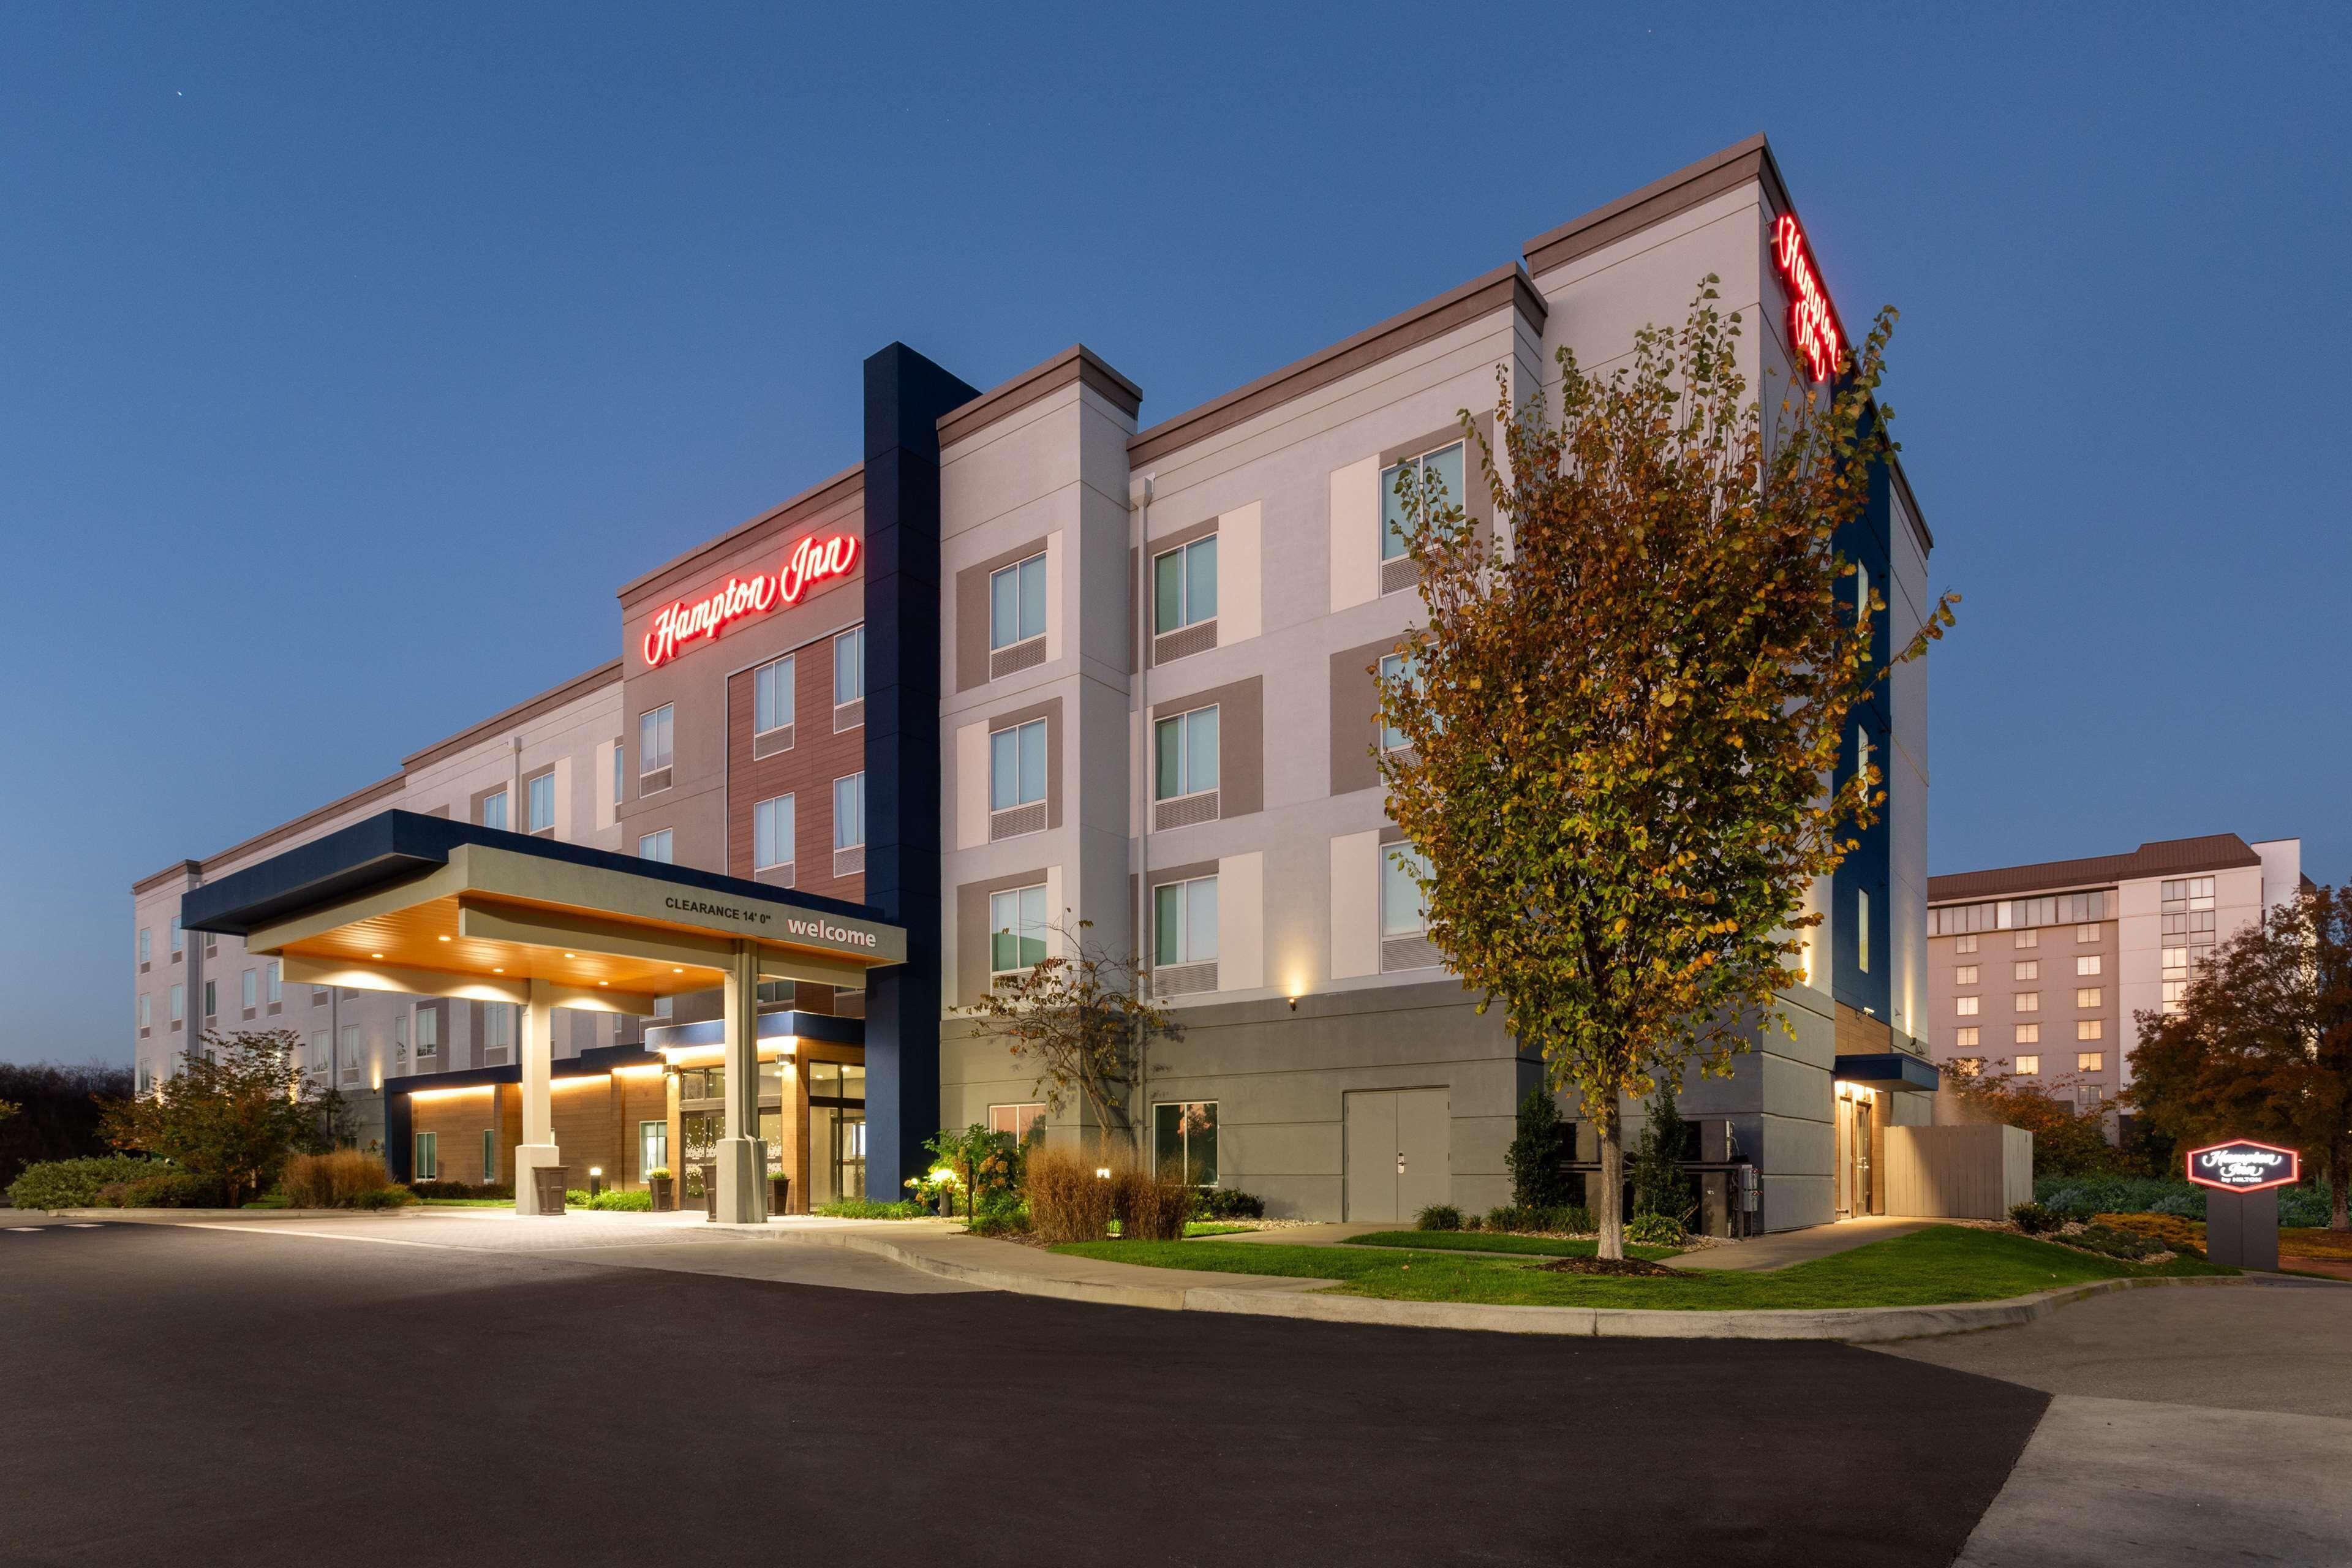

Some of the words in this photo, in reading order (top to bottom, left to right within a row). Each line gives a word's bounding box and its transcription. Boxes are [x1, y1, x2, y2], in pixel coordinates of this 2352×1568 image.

[1779, 216, 1841, 371] Hampton
[1795, 301, 1825, 381] Inn
[644, 575, 777, 665] Hampton
[781, 537, 858, 603] Inn
[665, 897, 740, 920] CLEARANCE
[742, 910, 757, 922] 14'
[787, 919, 876, 948] welcome
[2202, 1150, 2282, 1167] Hampton
[2220, 1163, 2264, 1177] Inn
